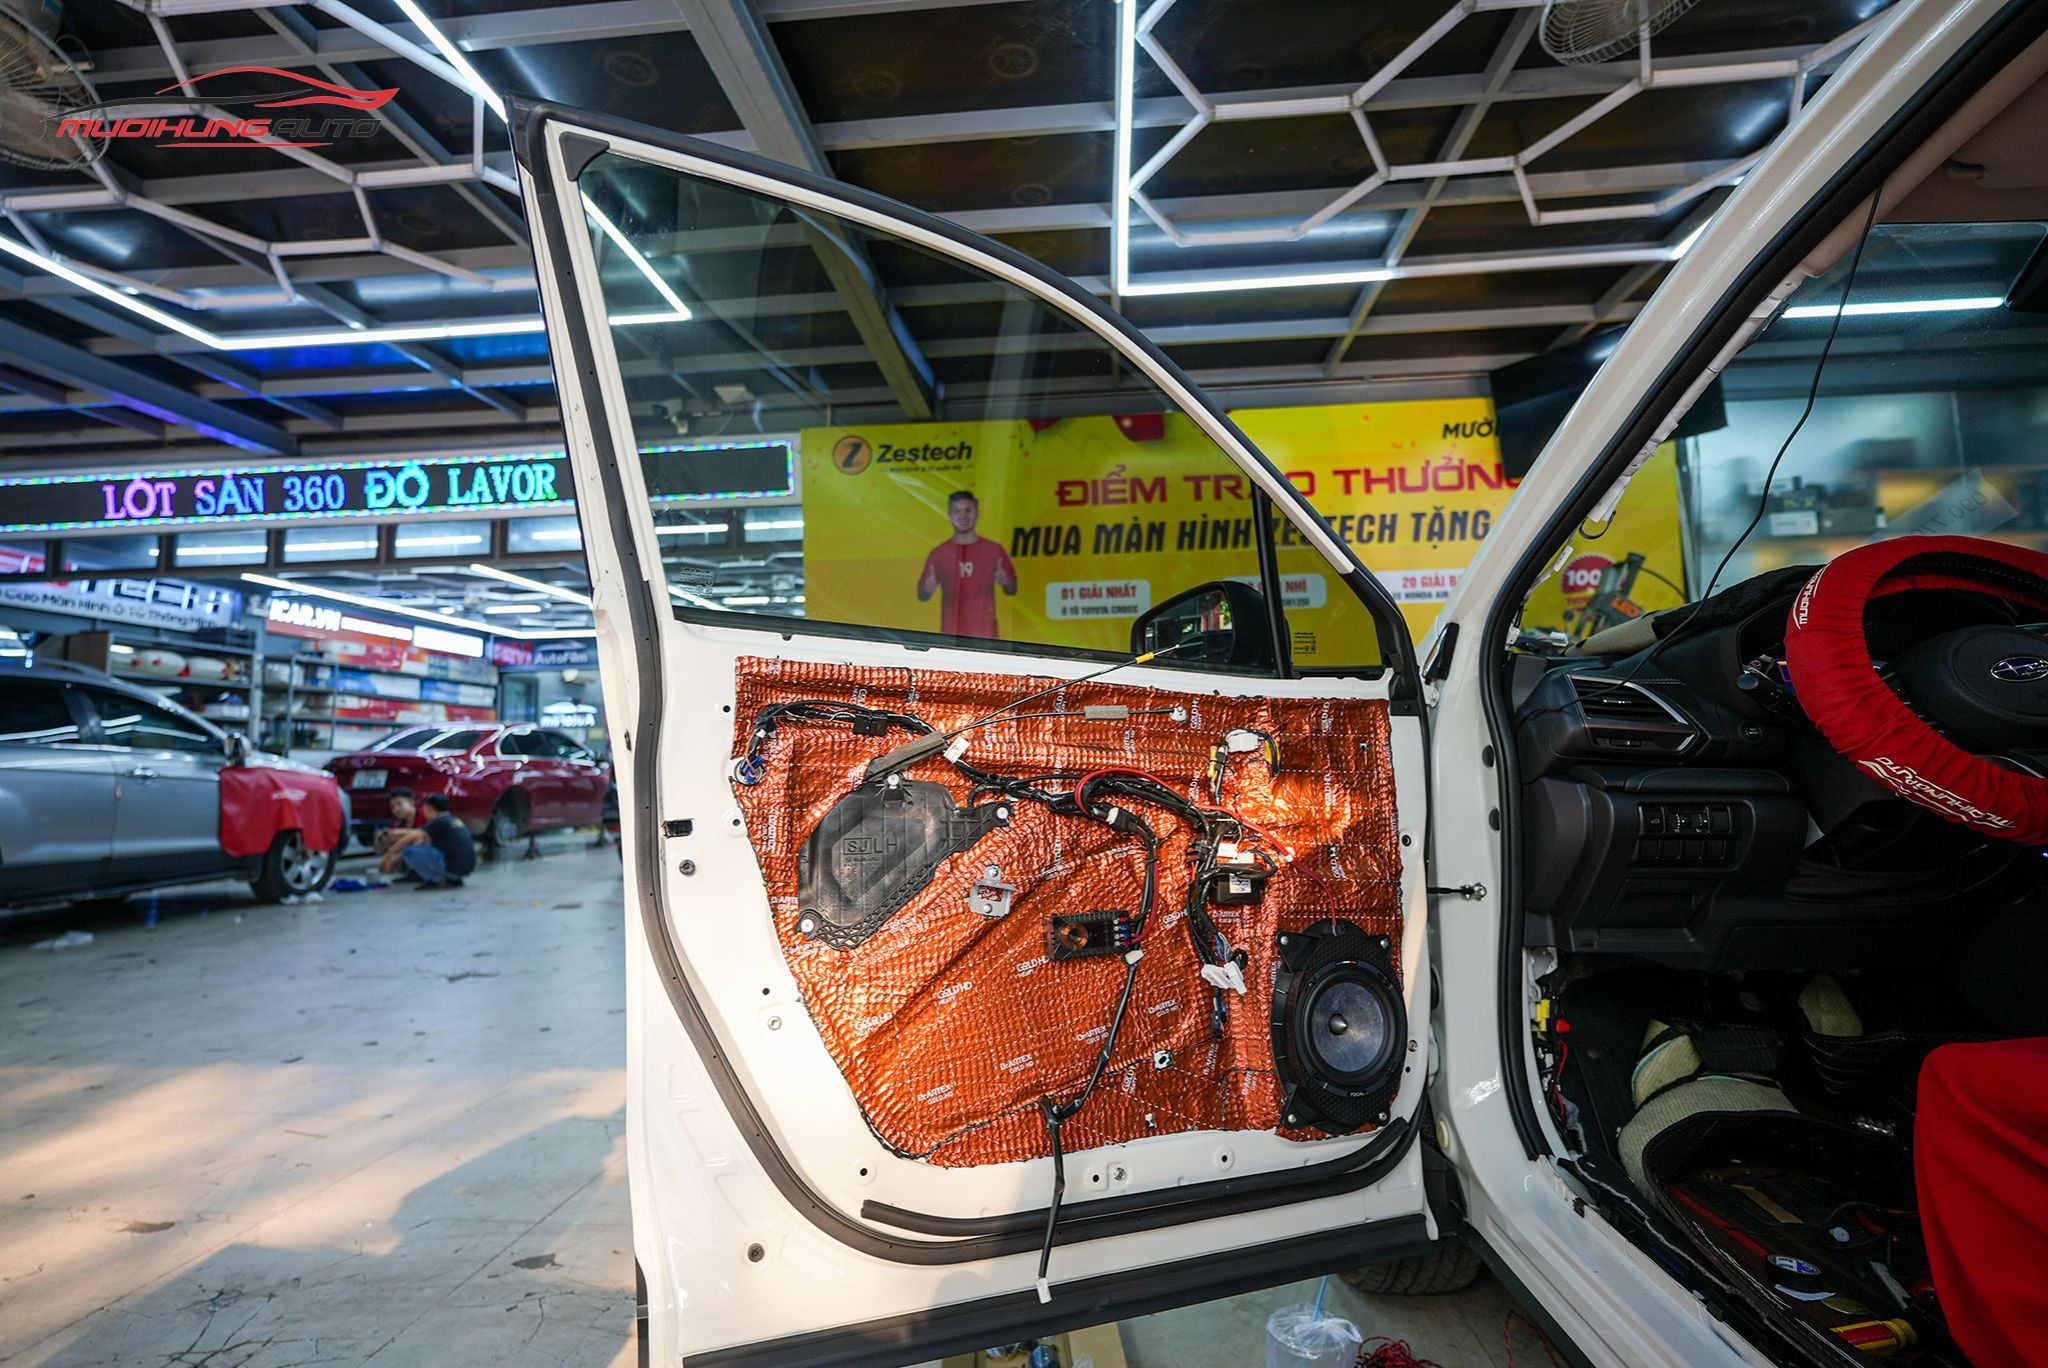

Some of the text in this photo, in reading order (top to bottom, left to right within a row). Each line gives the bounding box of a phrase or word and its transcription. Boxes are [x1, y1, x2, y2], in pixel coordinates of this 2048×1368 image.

[1442, 417, 1499, 439] MƯỜ
[877, 441, 972, 464] Zestech
[283, 475, 346, 511] 360
[447, 463, 557, 505] LAVOR
[1055, 457, 1522, 507] ĐIỂM TRO THƯỞN
[1011, 506, 1491, 558] MUA MÀN HÌNH ZETECH TẶNG
[959, 562, 974, 578] 19
[1566, 569, 1603, 587] 100
[1061, 582, 1137, 600] 01 GIẢI NHẤT
[1402, 576, 1417, 588] 20
[1016, 959, 1038, 972] GOLD
[937, 985, 959, 999] GOLD
